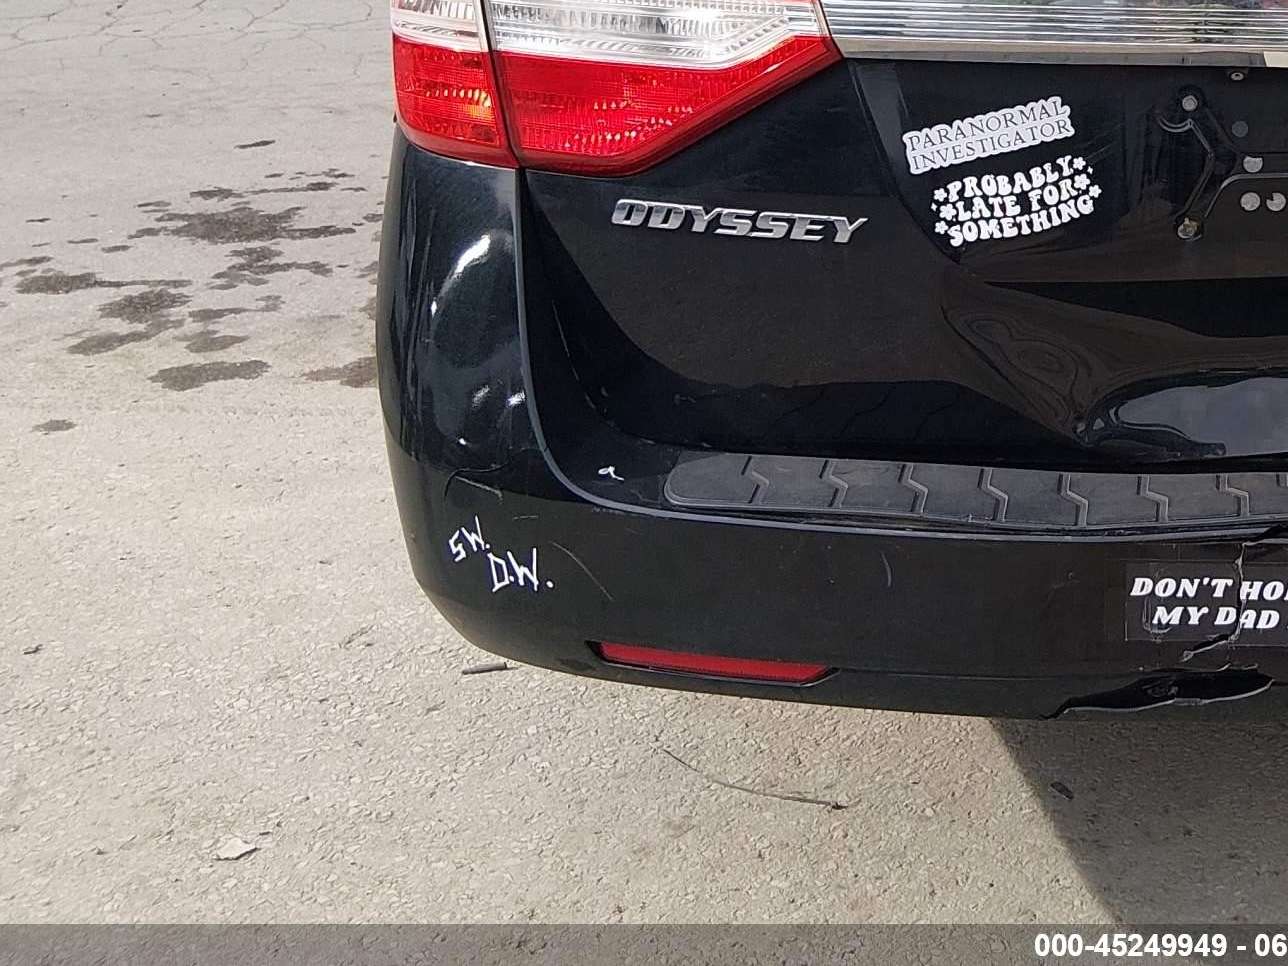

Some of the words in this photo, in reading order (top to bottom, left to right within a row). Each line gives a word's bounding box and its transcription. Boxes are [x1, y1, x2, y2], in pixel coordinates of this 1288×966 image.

[908, 99, 1067, 152] PARANORMAL
[912, 118, 1072, 170] INVESTIGATOR
[946, 155, 1074, 203] PROBABLY
[955, 195, 1021, 222] LATE
[1028, 178, 1079, 212] FOR
[611, 198, 869, 244] ODYSSEY
[947, 194, 1095, 247] SOMETHING
[1129, 577, 1234, 598] DON'T
[1151, 605, 1209, 625] MY
[1213, 606, 1281, 629] DAD
